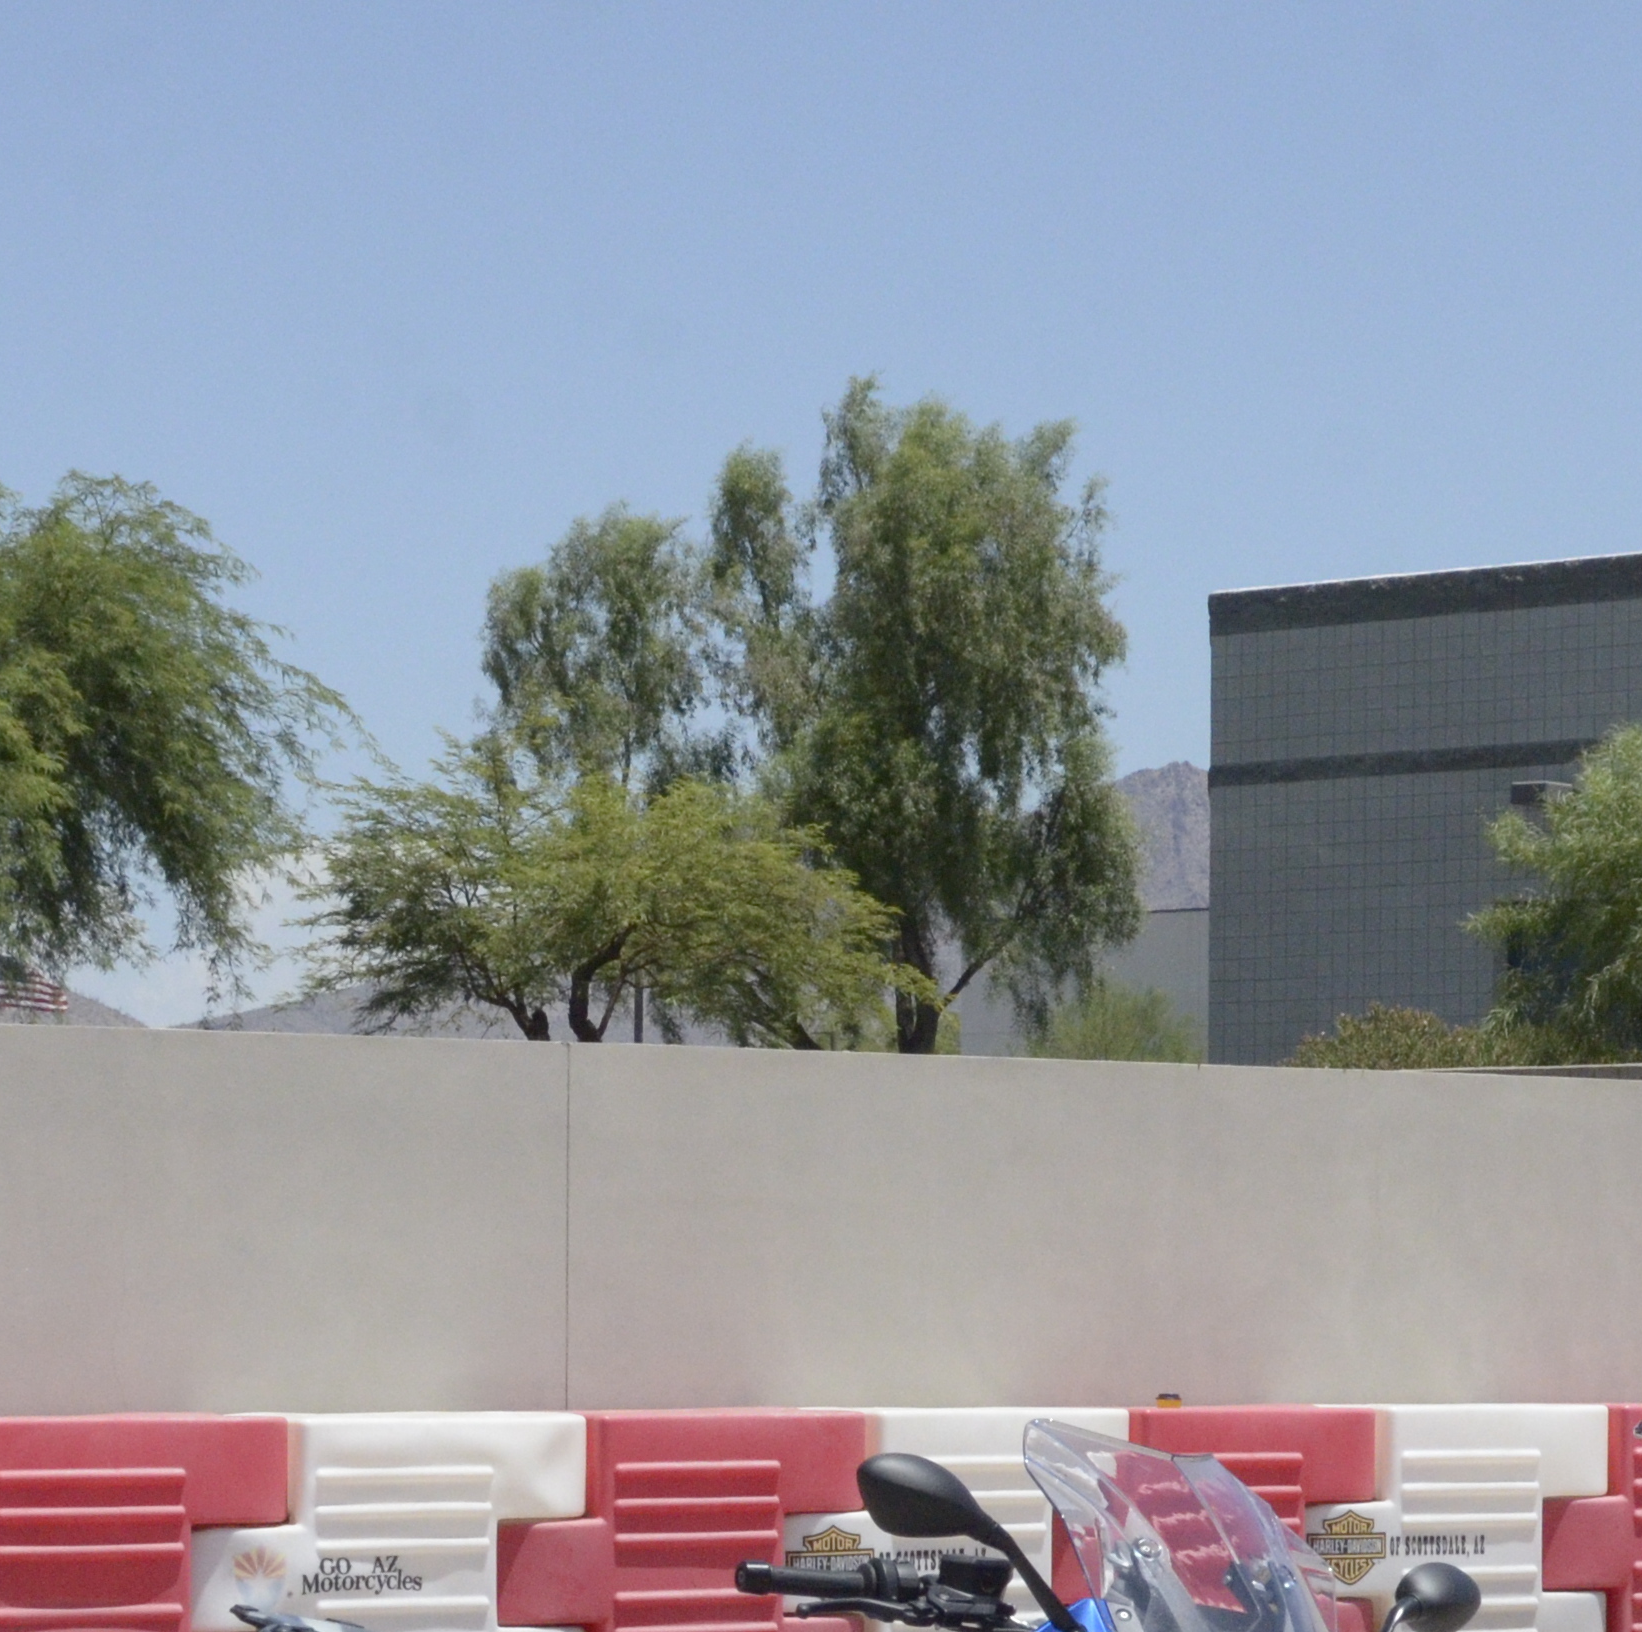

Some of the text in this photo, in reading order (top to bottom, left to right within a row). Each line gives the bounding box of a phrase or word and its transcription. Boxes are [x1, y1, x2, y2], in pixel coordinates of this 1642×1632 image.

[1331, 1516, 1367, 1534] MOTOR
[813, 1532, 854, 1551] MOTOR
[1390, 1536, 1400, 1556] OF
[1405, 1535, 1469, 1557] SCOTTSDALE,
[1474, 1535, 1485, 1554] AZ
[319, 1556, 399, 1575] GO AZ
[302, 1570, 423, 1595] Motorcycles
